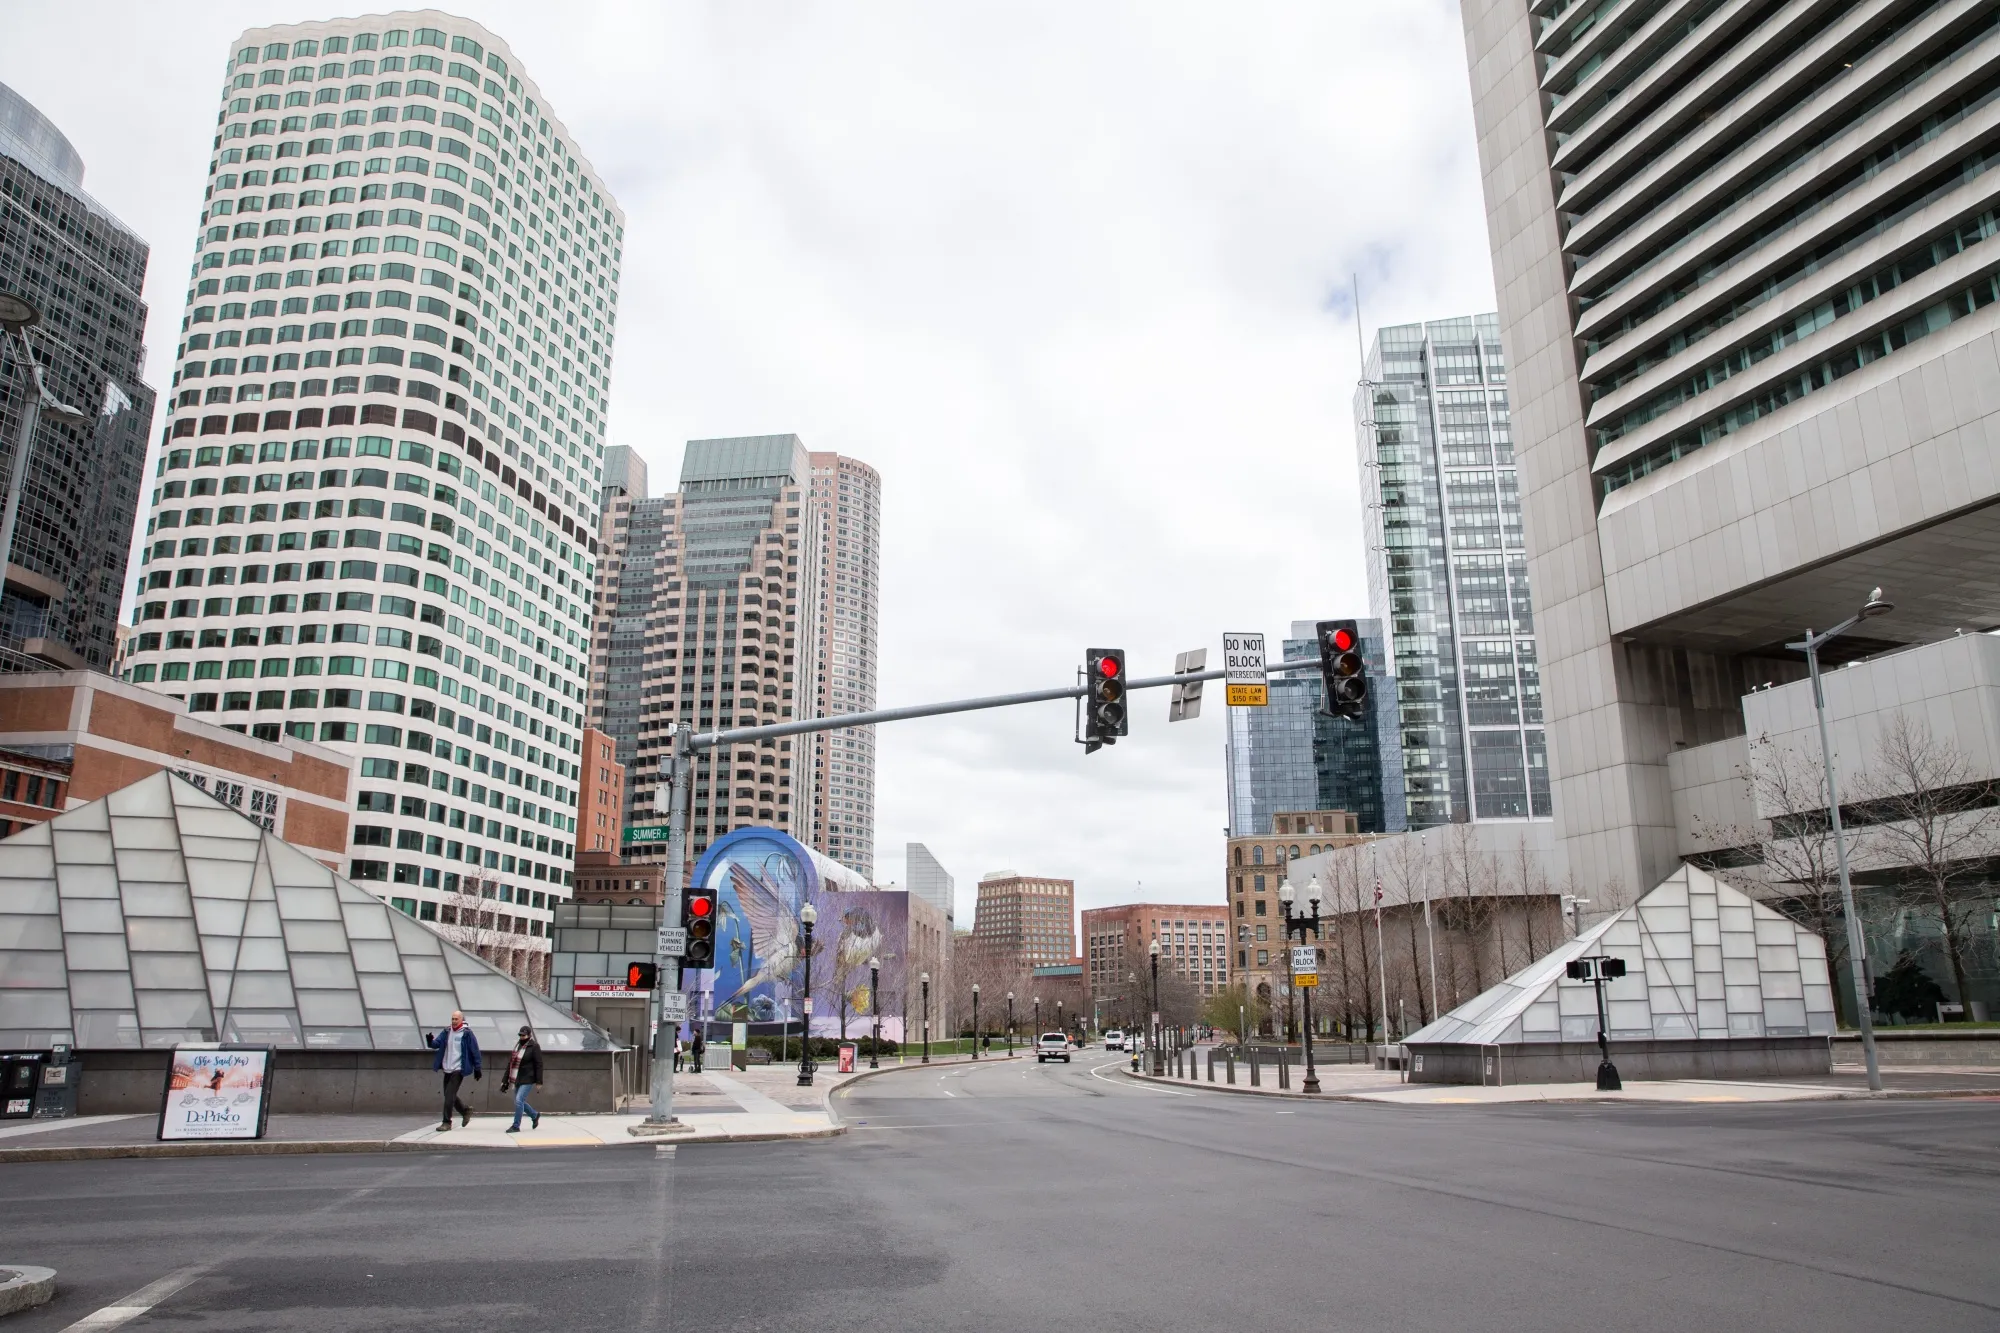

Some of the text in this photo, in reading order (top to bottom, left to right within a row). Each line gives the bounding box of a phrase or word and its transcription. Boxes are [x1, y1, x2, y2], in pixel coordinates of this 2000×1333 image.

[1226, 639, 1262, 651] DO NOT
[1229, 655, 1262, 668] BLOCK
[1227, 670, 1265, 679] INTERSECTION
[632, 828, 662, 840] SUMMER
[1294, 948, 1314, 957] DO NOT
[1295, 958, 1315, 966] BLOCK
[213, 1054, 233, 1067] Said
[186, 1109, 241, 1123] DePrisco
